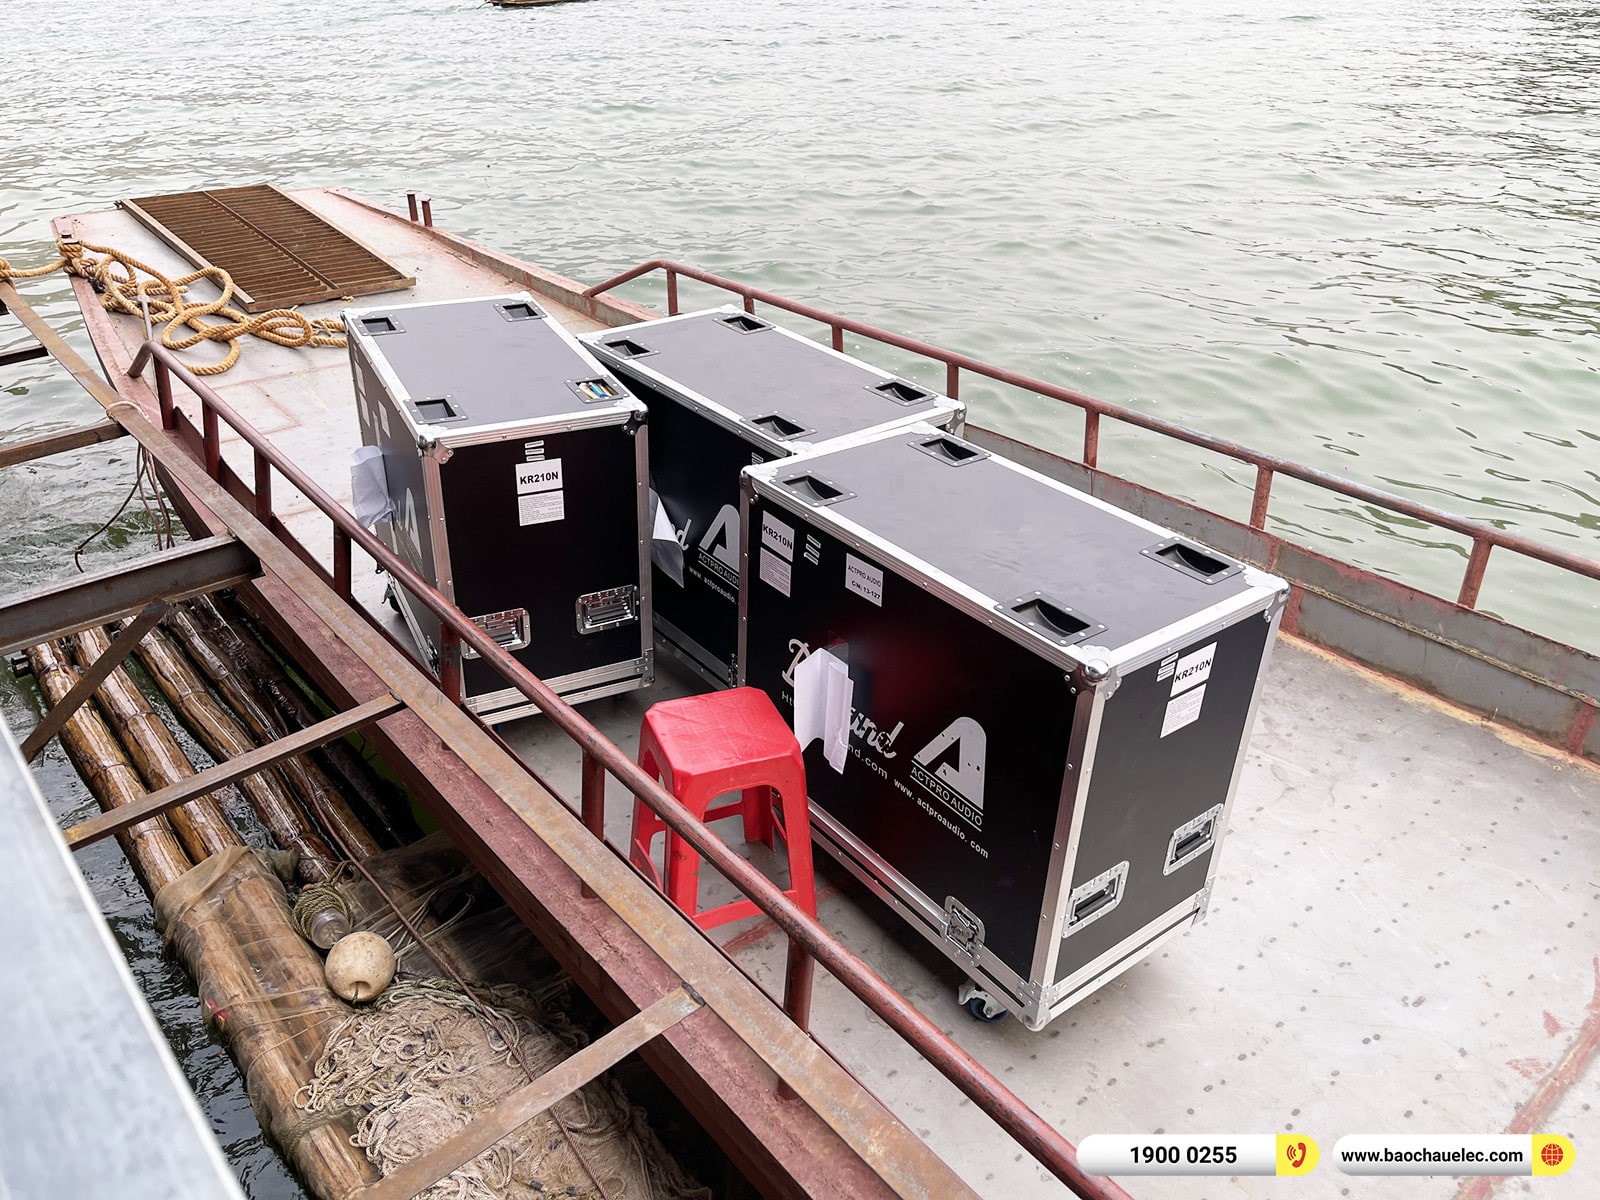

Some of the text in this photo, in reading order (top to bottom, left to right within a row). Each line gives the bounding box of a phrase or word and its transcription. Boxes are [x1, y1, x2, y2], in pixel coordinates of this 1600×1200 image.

[519, 471, 560, 486] KR210N
[762, 523, 793, 550] KR210N
[698, 552, 740, 586] ACTPRO AUDI
[847, 565, 882, 588] ACTPRO AUDIO
[1174, 658, 1212, 683] KR210N
[911, 766, 983, 826] ACTPRO AUDIO
